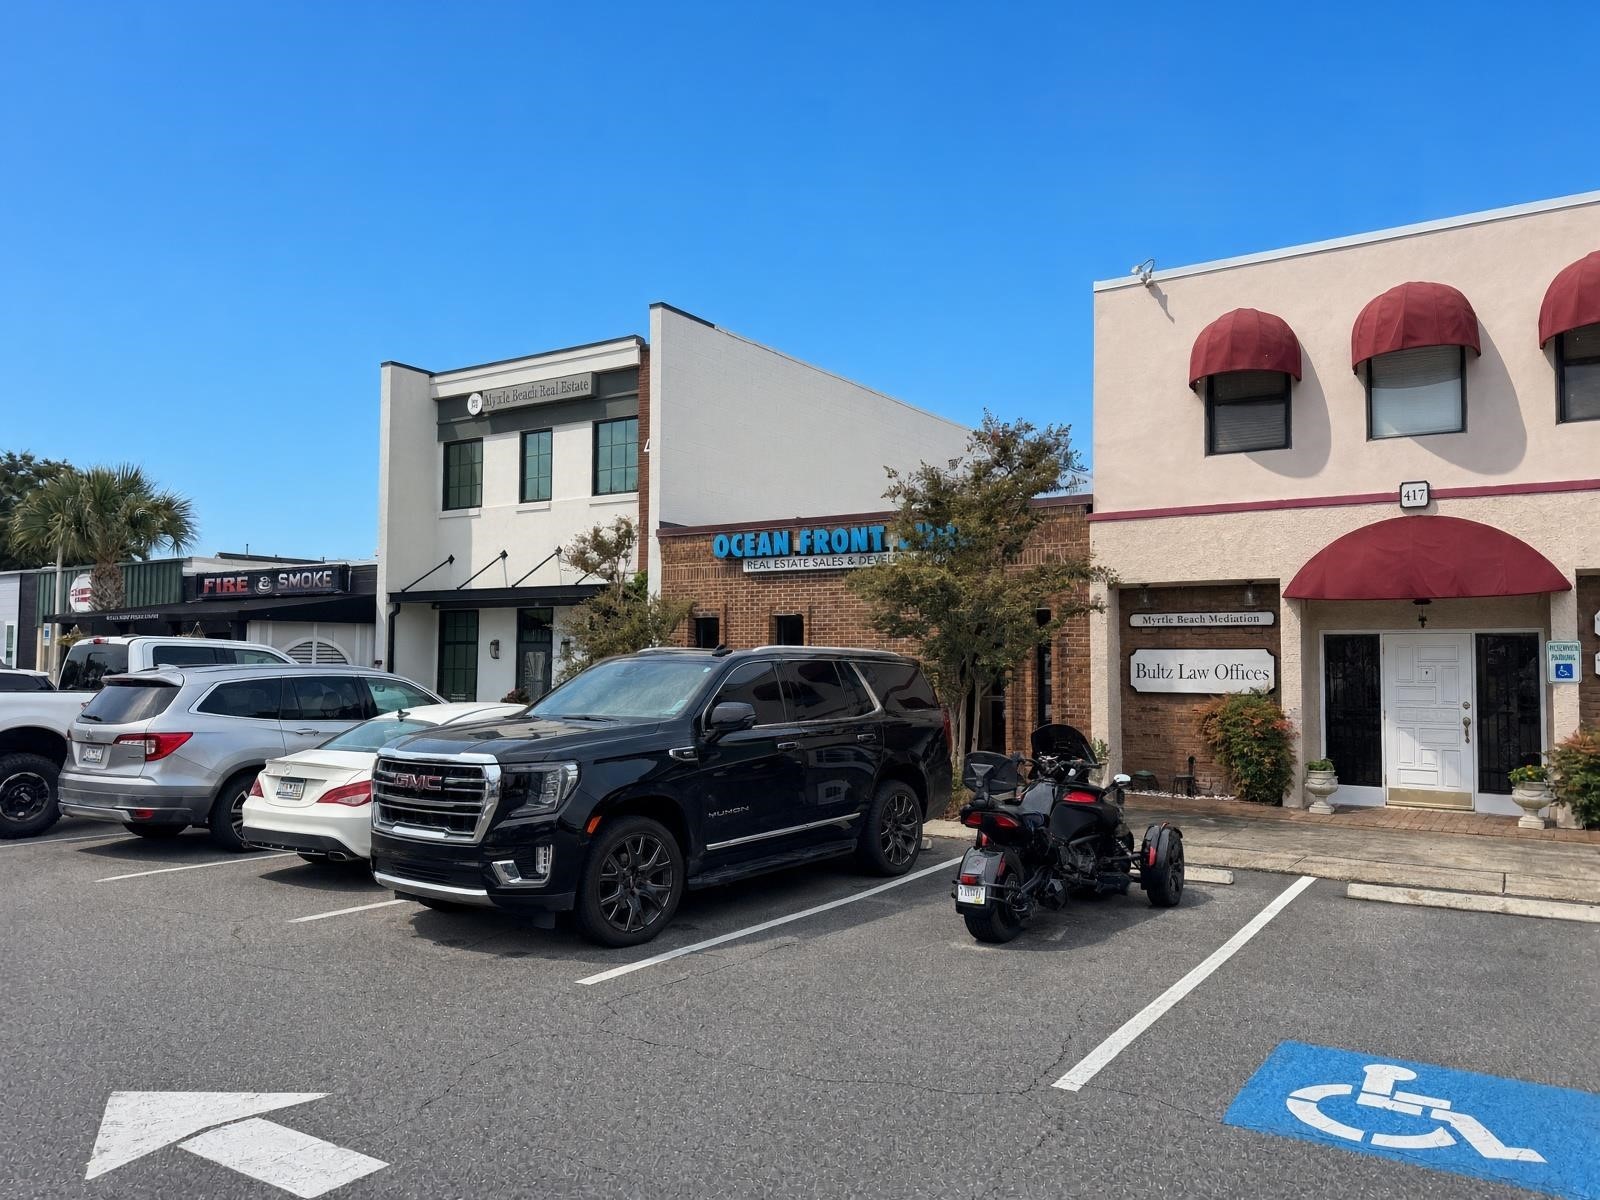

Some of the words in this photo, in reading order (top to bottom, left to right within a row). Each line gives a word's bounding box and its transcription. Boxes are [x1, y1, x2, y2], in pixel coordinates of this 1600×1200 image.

[512, 385, 538, 401] Beach
[540, 380, 559, 397] Real
[561, 379, 589, 394] Estate
[1403, 489, 1425, 501] 417
[713, 530, 789, 558] OCEAN
[800, 525, 885, 554] FRONT
[747, 559, 771, 570] REAL
[774, 557, 808, 569] ESTATE
[812, 556, 844, 567] SALES
[847, 556, 855, 565] &
[203, 576, 249, 593] FIRE
[277, 570, 332, 589] SMOKE
[1142, 614, 1174, 625] Myrtle
[1177, 614, 1206, 623] Beach
[1208, 613, 1260, 623] Mediation
[1135, 663, 1174, 680] Bultz
[1178, 663, 1210, 680] Law
[1214, 663, 1270, 681] Offices
[394, 773, 442, 791] GMC
